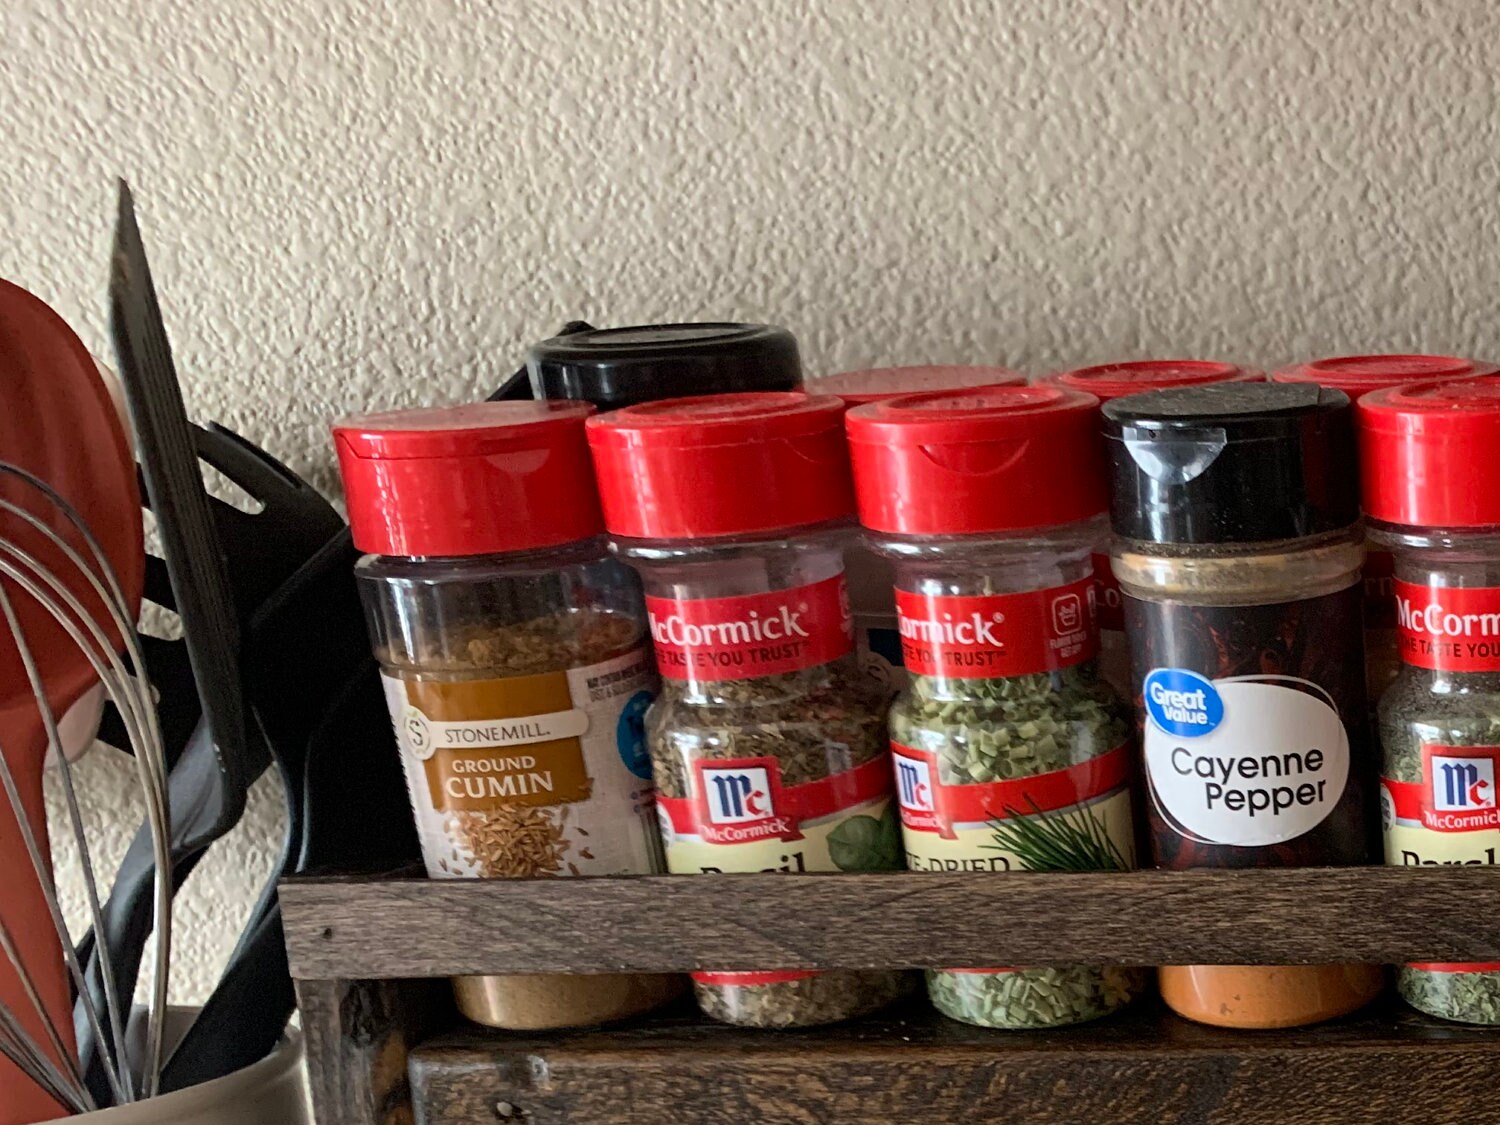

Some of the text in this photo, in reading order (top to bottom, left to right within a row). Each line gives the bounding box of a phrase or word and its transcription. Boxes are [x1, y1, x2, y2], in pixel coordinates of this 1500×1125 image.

[898, 611, 1004, 647] ormick
[707, 650, 744, 667] YOU
[747, 641, 800, 665] TRUST
[1150, 682, 1208, 711] Great
[1162, 705, 1208, 726] Value
[452, 755, 536, 774] GROUND
[1171, 747, 1324, 786] Cayenne
[446, 770, 555, 799] CUMIN
[1205, 778, 1327, 818] Pepper
[700, 818, 791, 842] McCormick
